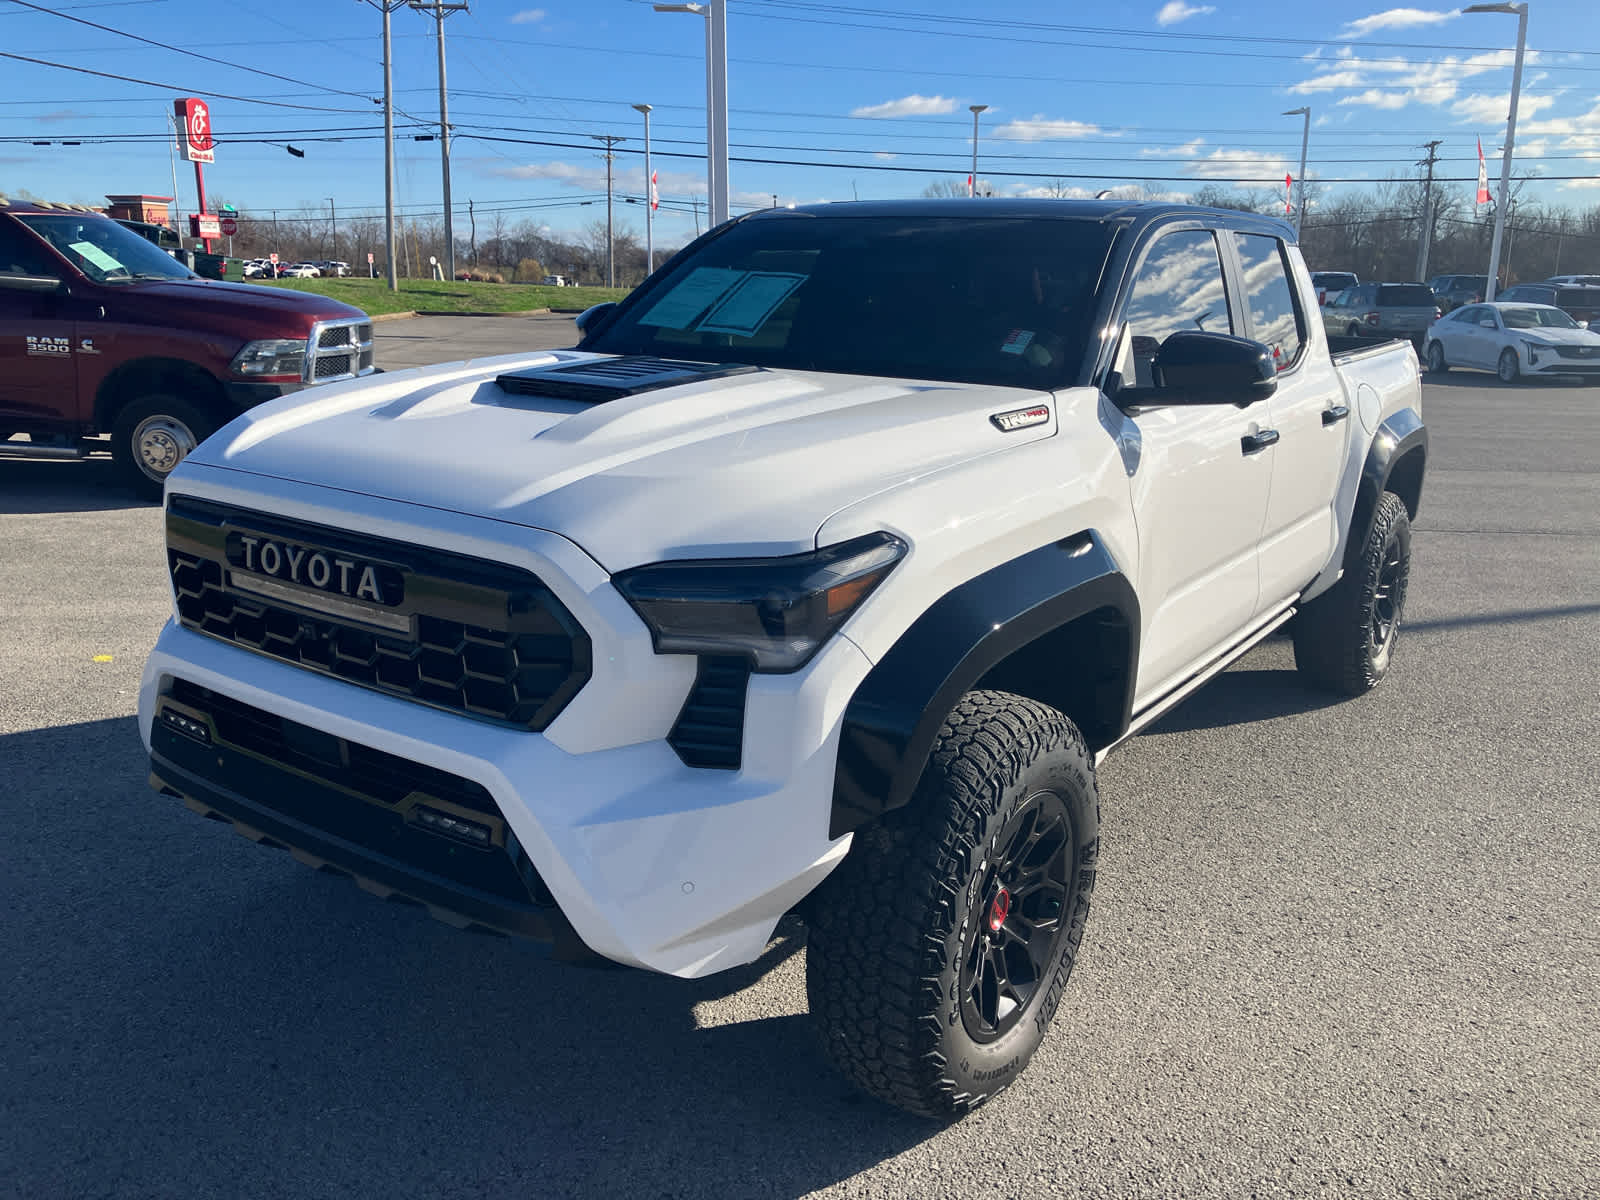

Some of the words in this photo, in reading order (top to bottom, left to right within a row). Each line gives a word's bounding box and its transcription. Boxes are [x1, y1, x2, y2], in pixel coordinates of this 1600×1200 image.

[27, 336, 69, 345] RAM
[27, 343, 70, 352] 3500
[999, 412, 1027, 430] TRD
[241, 536, 385, 603] TOYOTA
